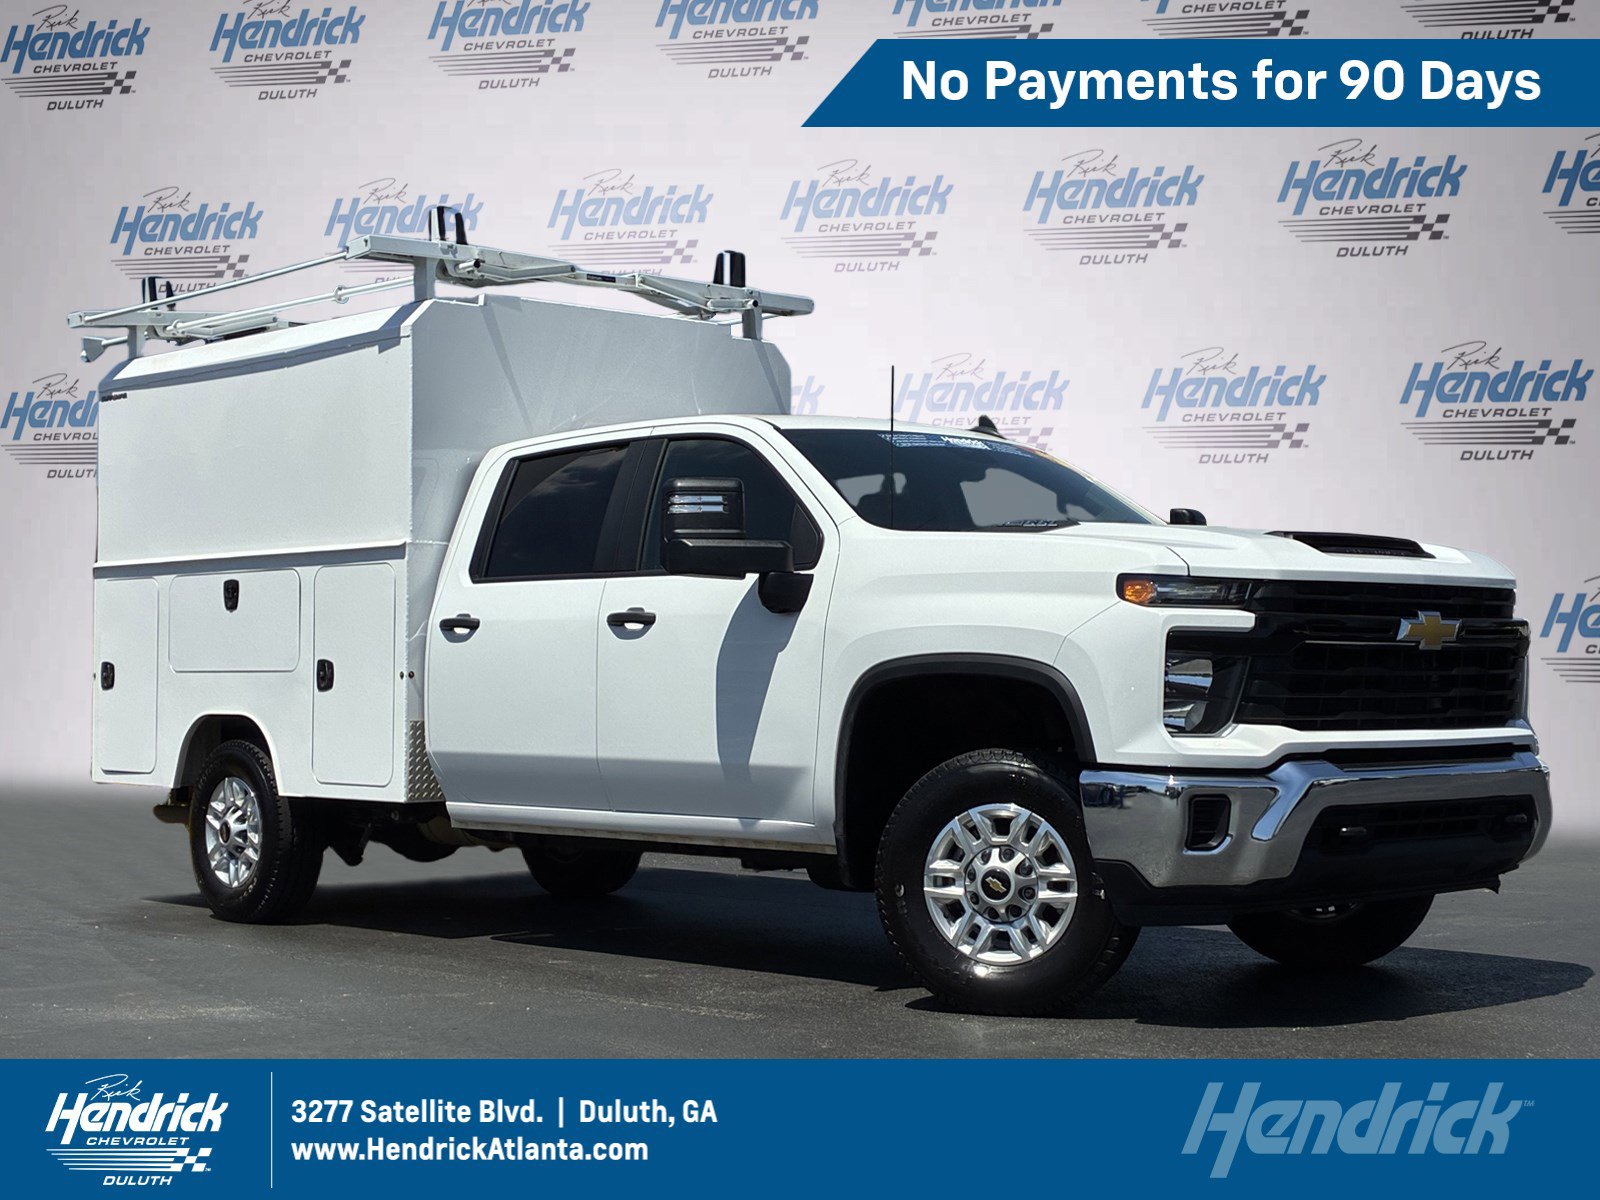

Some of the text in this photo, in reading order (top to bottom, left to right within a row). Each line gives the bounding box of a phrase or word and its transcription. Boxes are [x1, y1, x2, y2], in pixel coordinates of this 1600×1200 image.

[32, 5, 79, 31] Rick
[427, 0, 591, 52] Hendrick
[931, 13, 1032, 27] CHEVROLET
[209, 6, 366, 63] Hendrick
[692, 26, 788, 40] CHEVROLET
[0, 18, 150, 74] Hendrick
[464, 38, 556, 51] CHEVROLET
[244, 50, 332, 63] CHEVROLET
[33, 62, 118, 74] CHEVROLET
[708, 66, 773, 79] DULUTH
[478, 77, 540, 90] DULUTH
[47, 99, 104, 111] DULUTH
[258, 89, 318, 101] DULUTH
[1061, 148, 1119, 178] Rick
[1318, 138, 1377, 168] Rick
[583, 168, 636, 197] Rick
[817, 158, 872, 188] Rick
[358, 177, 409, 205] Rick
[1022, 164, 1206, 225] Hendrick
[1276, 154, 1468, 216] Hendrick
[143, 186, 191, 213] Rick
[779, 174, 954, 233] Hendrick
[1319, 203, 1427, 216] CHEVROLET
[547, 184, 715, 241] Hendrick
[1062, 212, 1165, 225] CHEVROLET
[110, 201, 265, 256] Hendrick
[584, 229, 679, 241] CHEVROLET
[818, 221, 917, 233] CHEVROLET
[144, 245, 231, 256] CHEVROLET
[1079, 253, 1149, 266] DULUTH
[1336, 246, 1409, 258] DULUTH
[834, 261, 901, 273] DULUTH
[1180, 346, 1239, 376] Rick
[1441, 340, 1502, 371] Rick
[33, 373, 80, 399] Rick
[1140, 364, 1328, 423] Hendrick
[1399, 358, 1595, 418] Hendrick
[893, 370, 1071, 423] Hendrick
[1182, 412, 1287, 423] CHEVROLET
[1442, 407, 1553, 419] CHEVROLET
[1199, 453, 1270, 464] DULUTH
[1460, 449, 1535, 461] DULUTH
